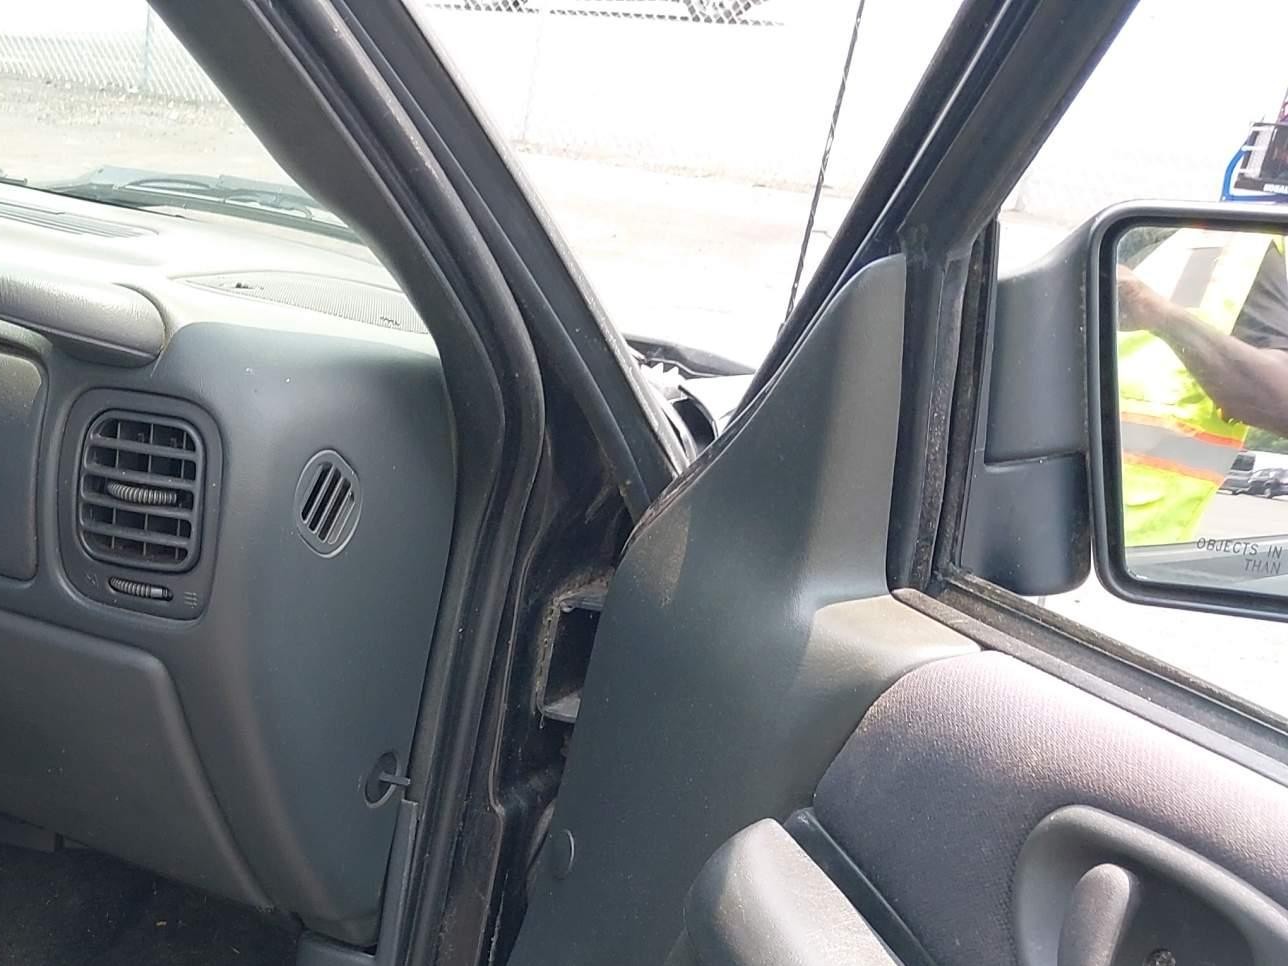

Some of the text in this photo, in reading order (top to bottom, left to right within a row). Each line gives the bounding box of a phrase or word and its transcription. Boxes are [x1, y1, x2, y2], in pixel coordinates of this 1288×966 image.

[1196, 537, 1283, 559] OBJECTS IN
[1244, 558, 1281, 575] THAN
